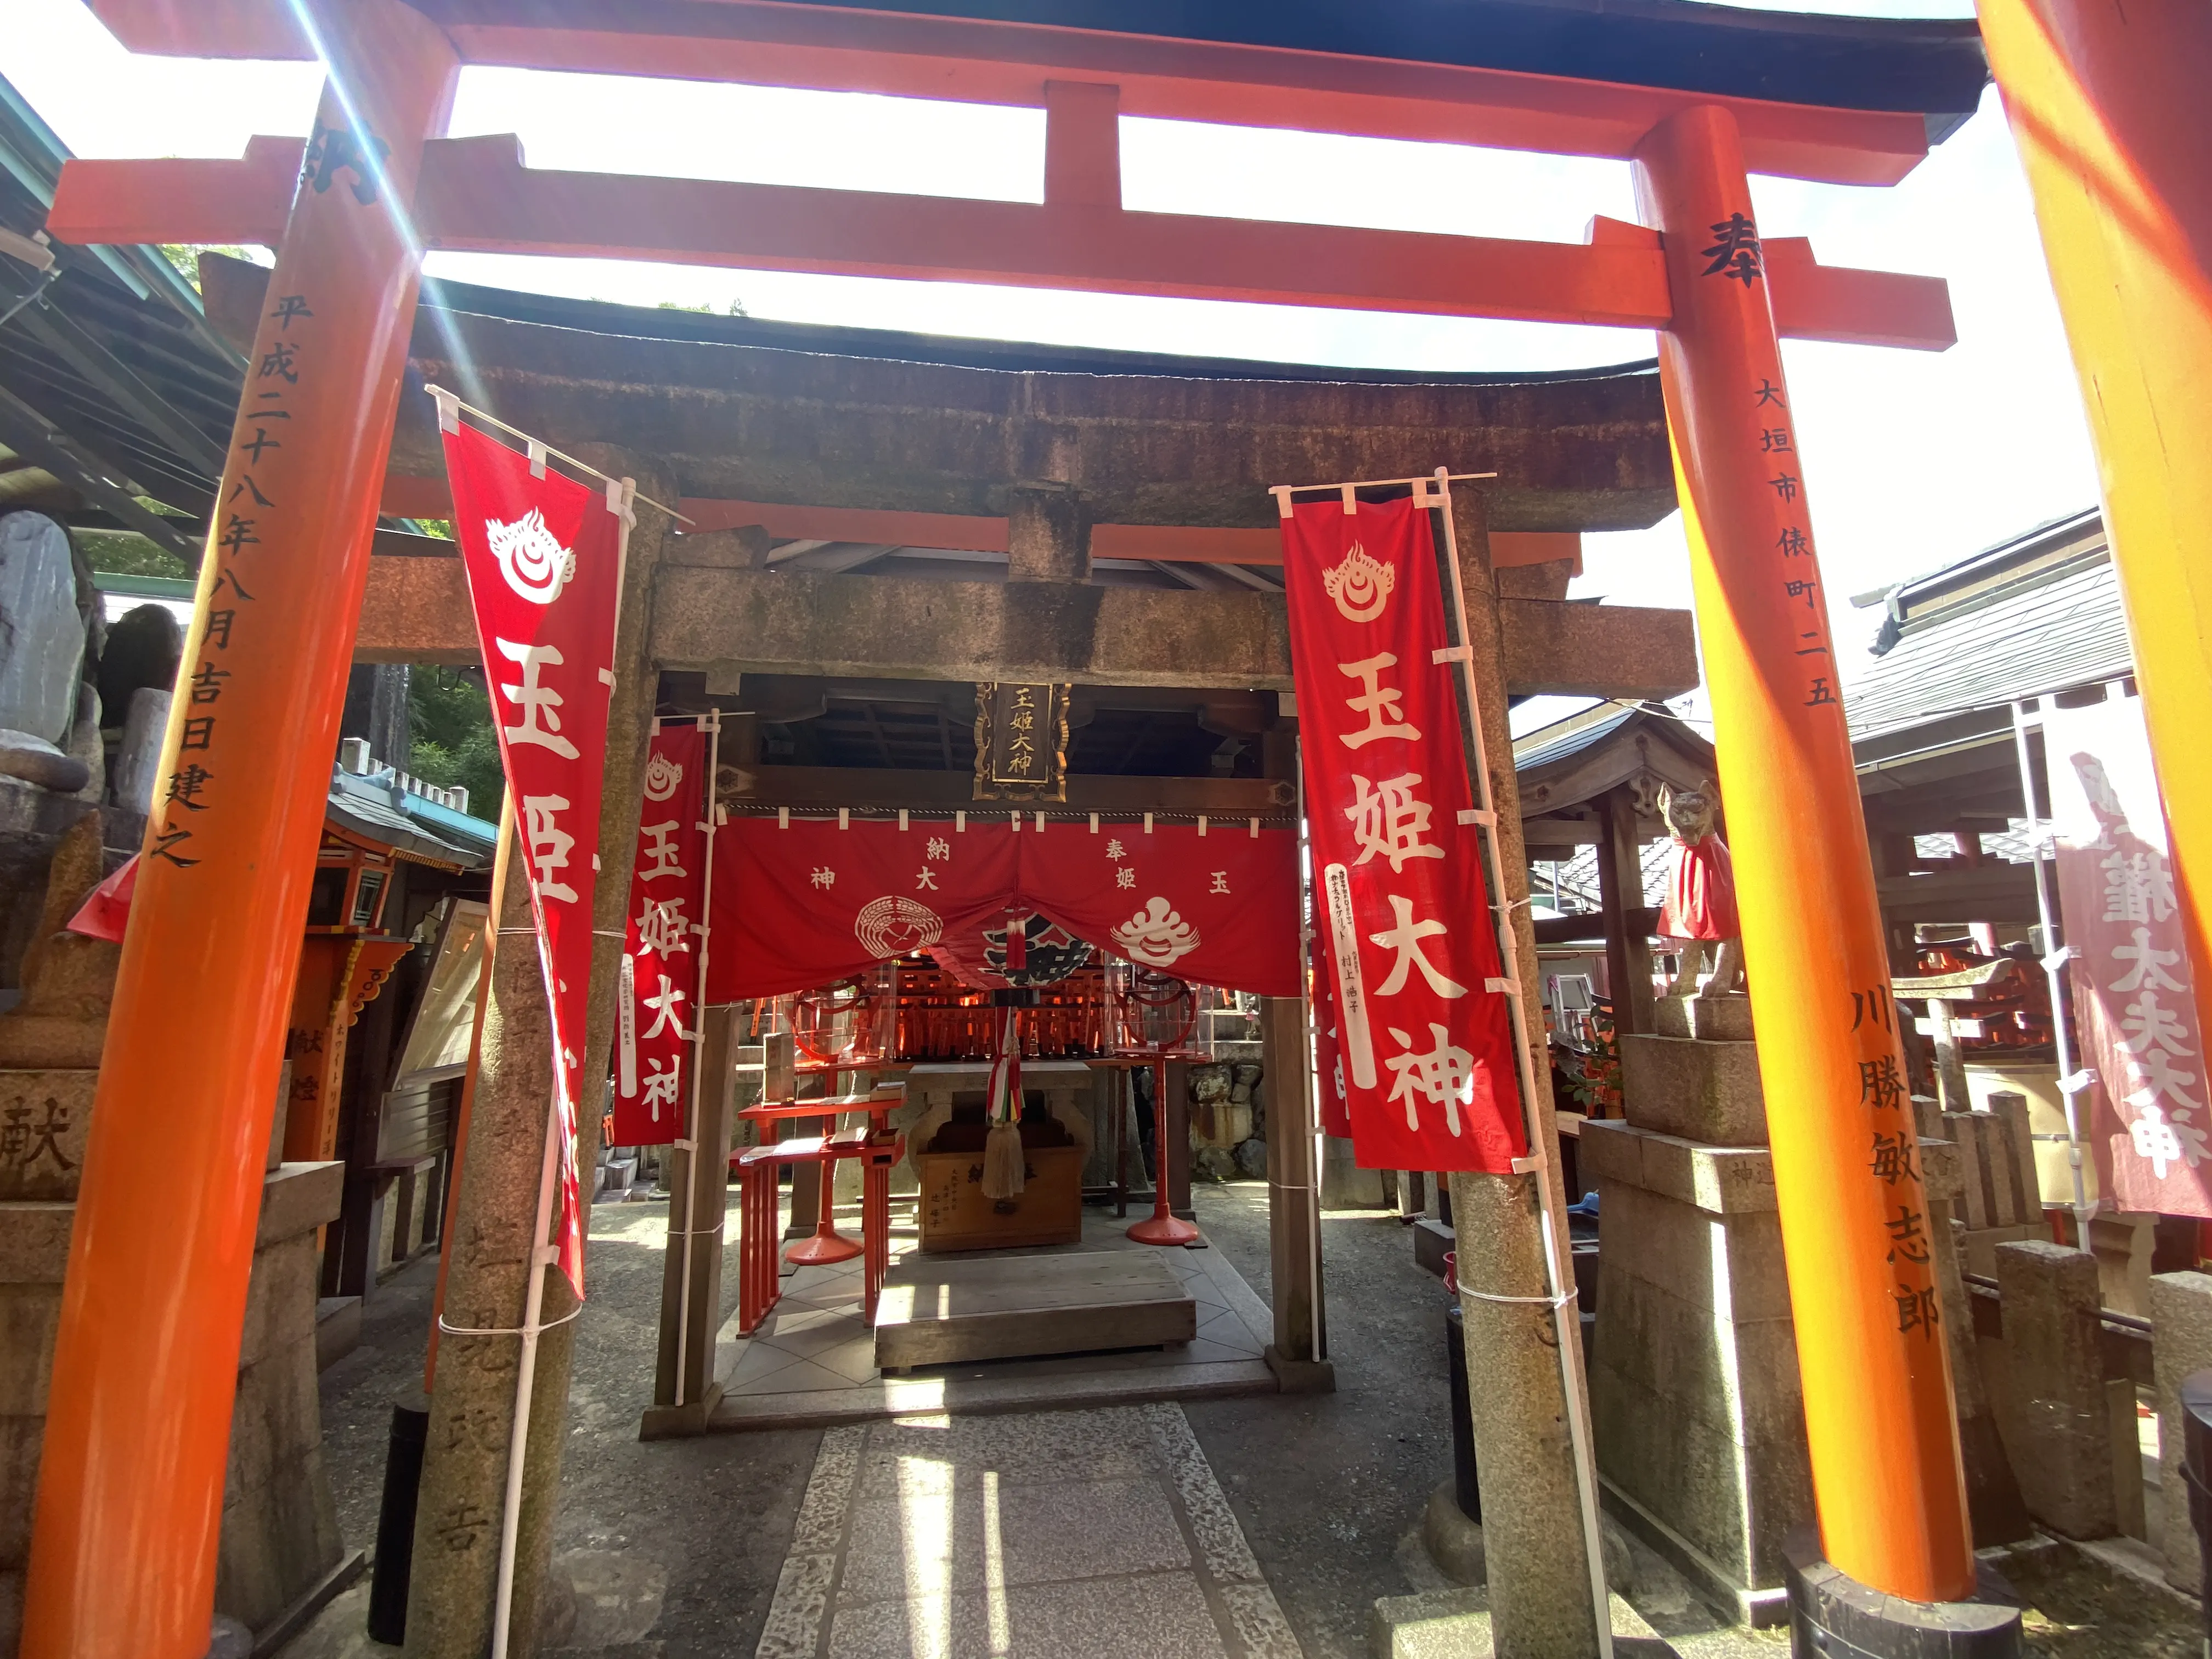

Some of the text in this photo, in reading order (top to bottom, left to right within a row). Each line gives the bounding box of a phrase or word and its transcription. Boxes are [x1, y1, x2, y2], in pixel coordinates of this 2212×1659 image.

[1700, 212, 1763, 288] 奉
[150, 295, 314, 868] 平成二十八年八月吉日建之
[1754, 379, 1836, 707] 大垣市俵町二五
[1007, 687, 1035, 776] 玉姫大神
[1338, 651, 1474, 1137] 玉姫大神
[635, 820, 690, 1122] 玉姫大神
[1851, 984, 1939, 1342] 川勝敏志郎
